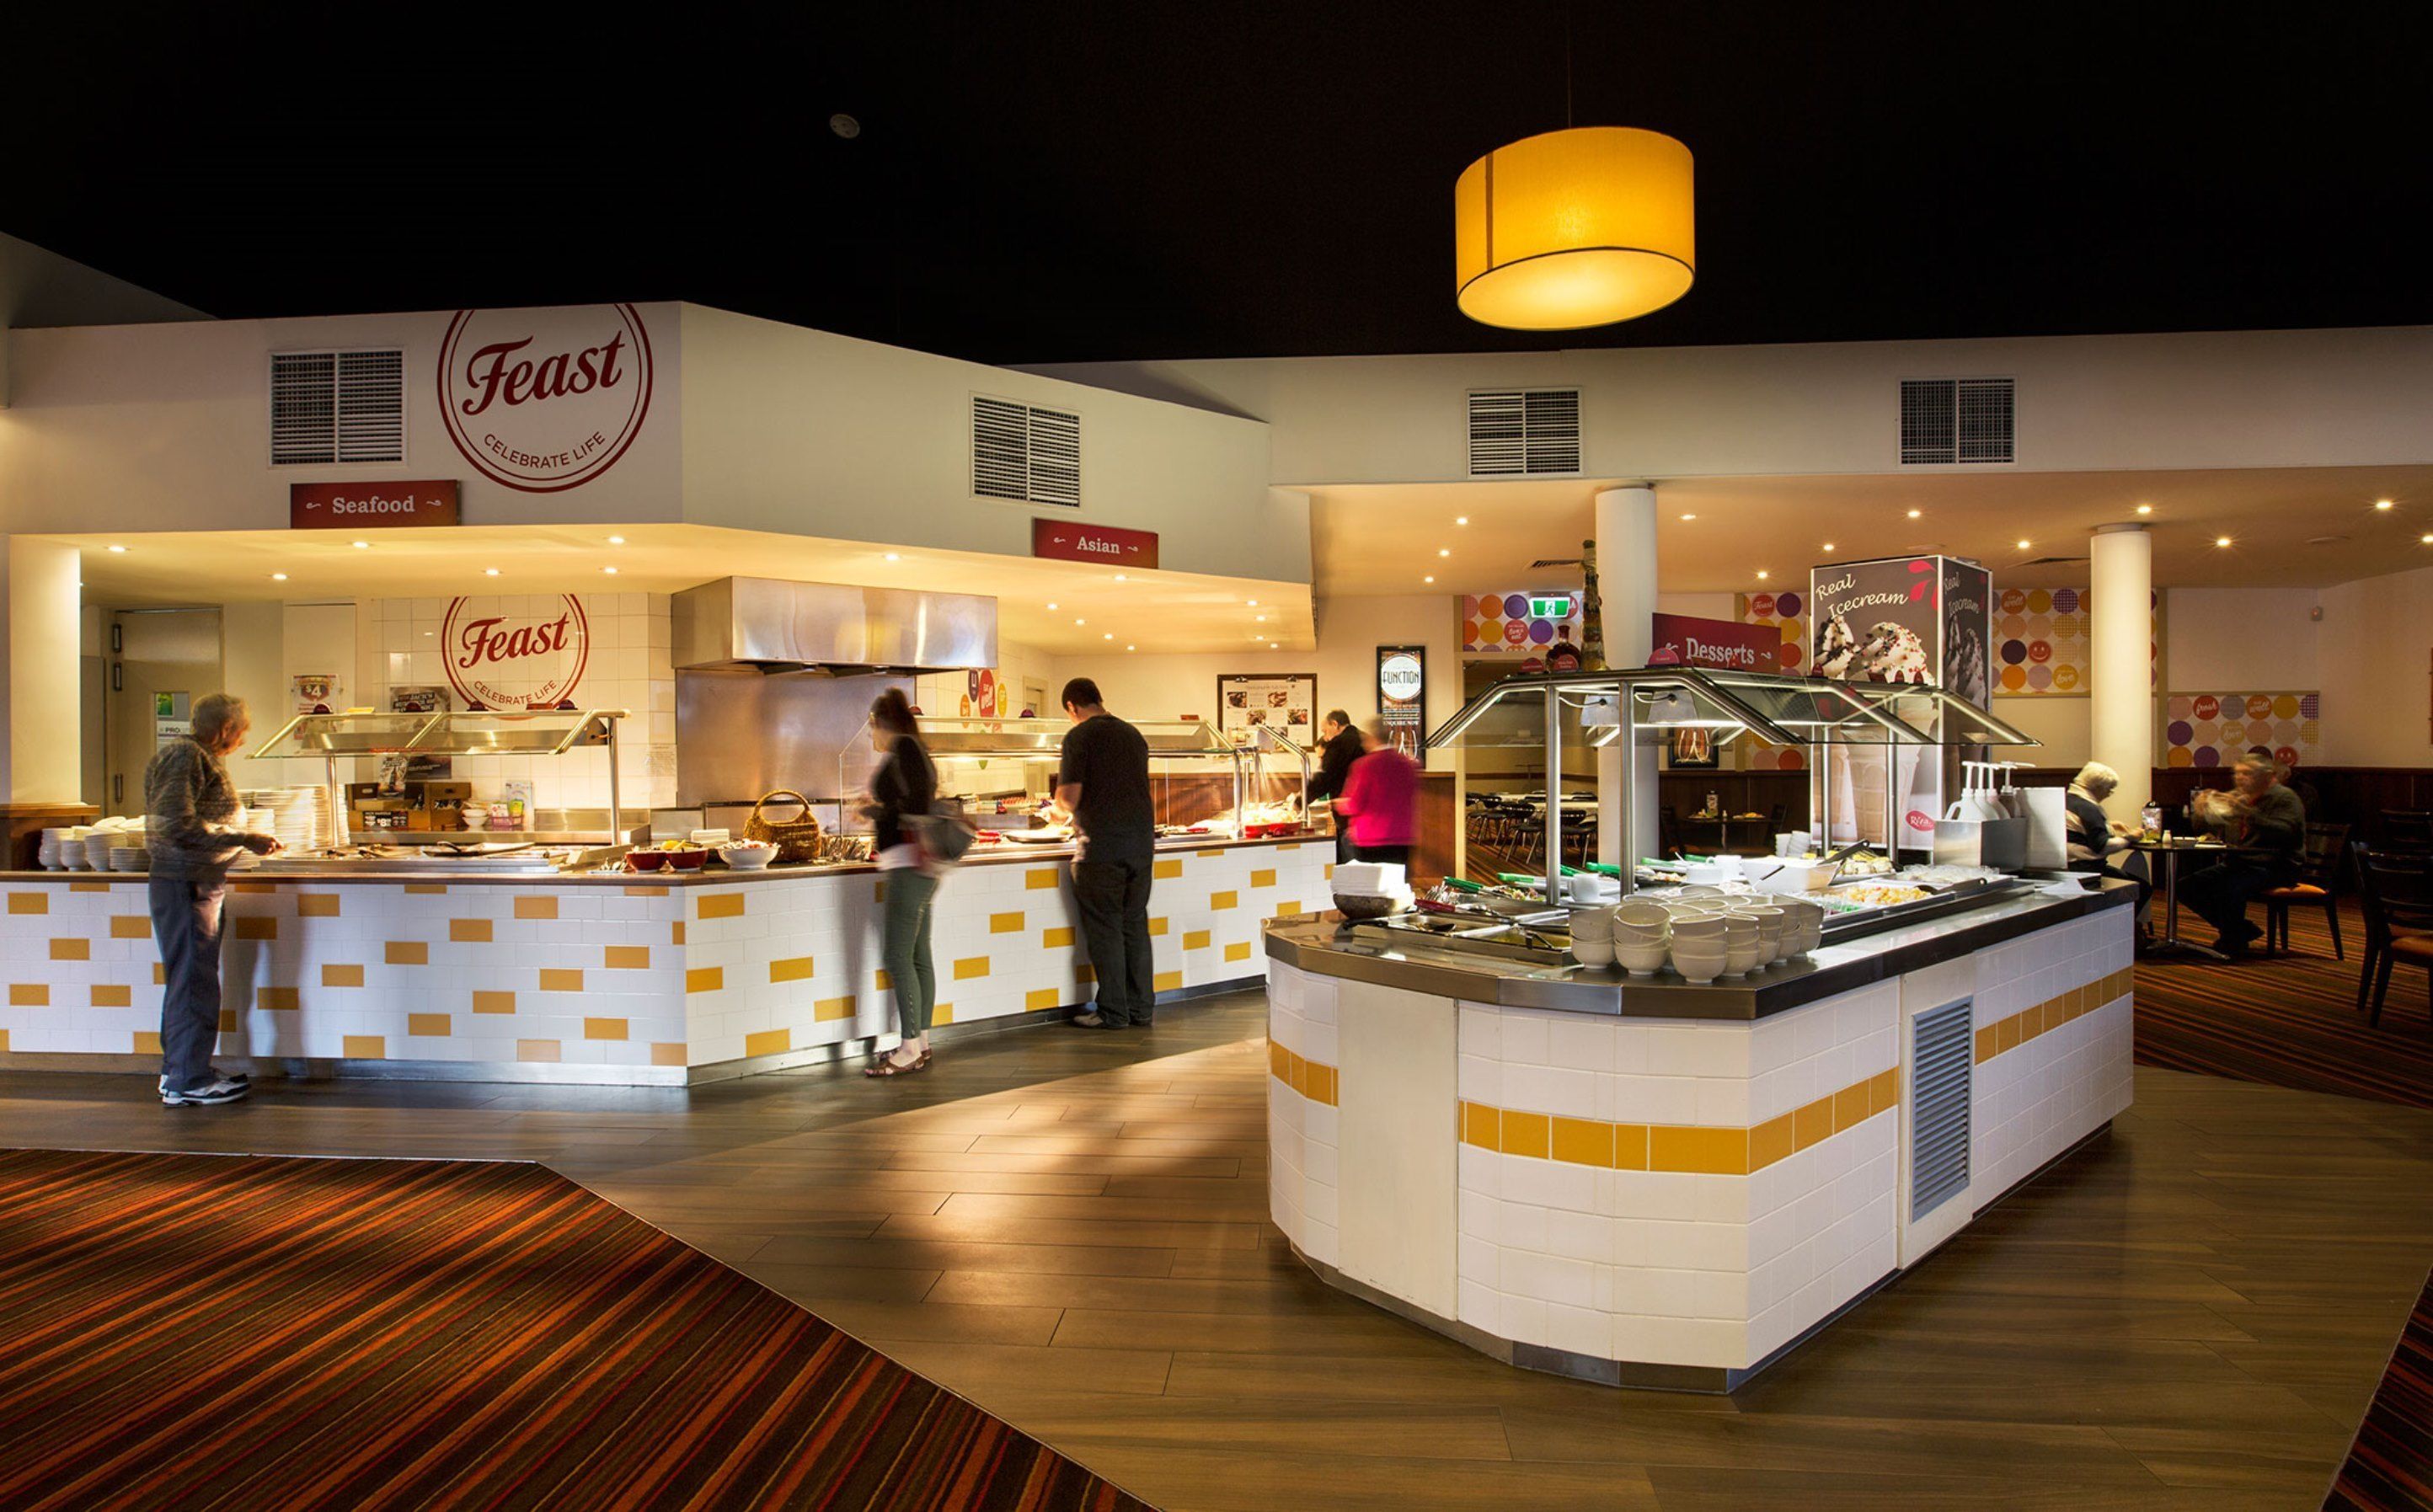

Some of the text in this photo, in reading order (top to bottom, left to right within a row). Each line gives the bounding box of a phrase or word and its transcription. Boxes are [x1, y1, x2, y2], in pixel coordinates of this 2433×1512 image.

[462, 329, 625, 416] Feast
[484, 431, 606, 468] CELEBRATE LIFE
[332, 494, 415, 514] Seafood
[1077, 536, 1120, 554] Asian
[1815, 573, 1857, 601] Real
[1827, 592, 1909, 620] Icecream
[458, 612, 570, 669] Feast
[1686, 637, 1755, 665] Desserts
[1382, 671, 1420, 684] FUNCTION
[473, 679, 558, 706] CELEBRATE LIFE
